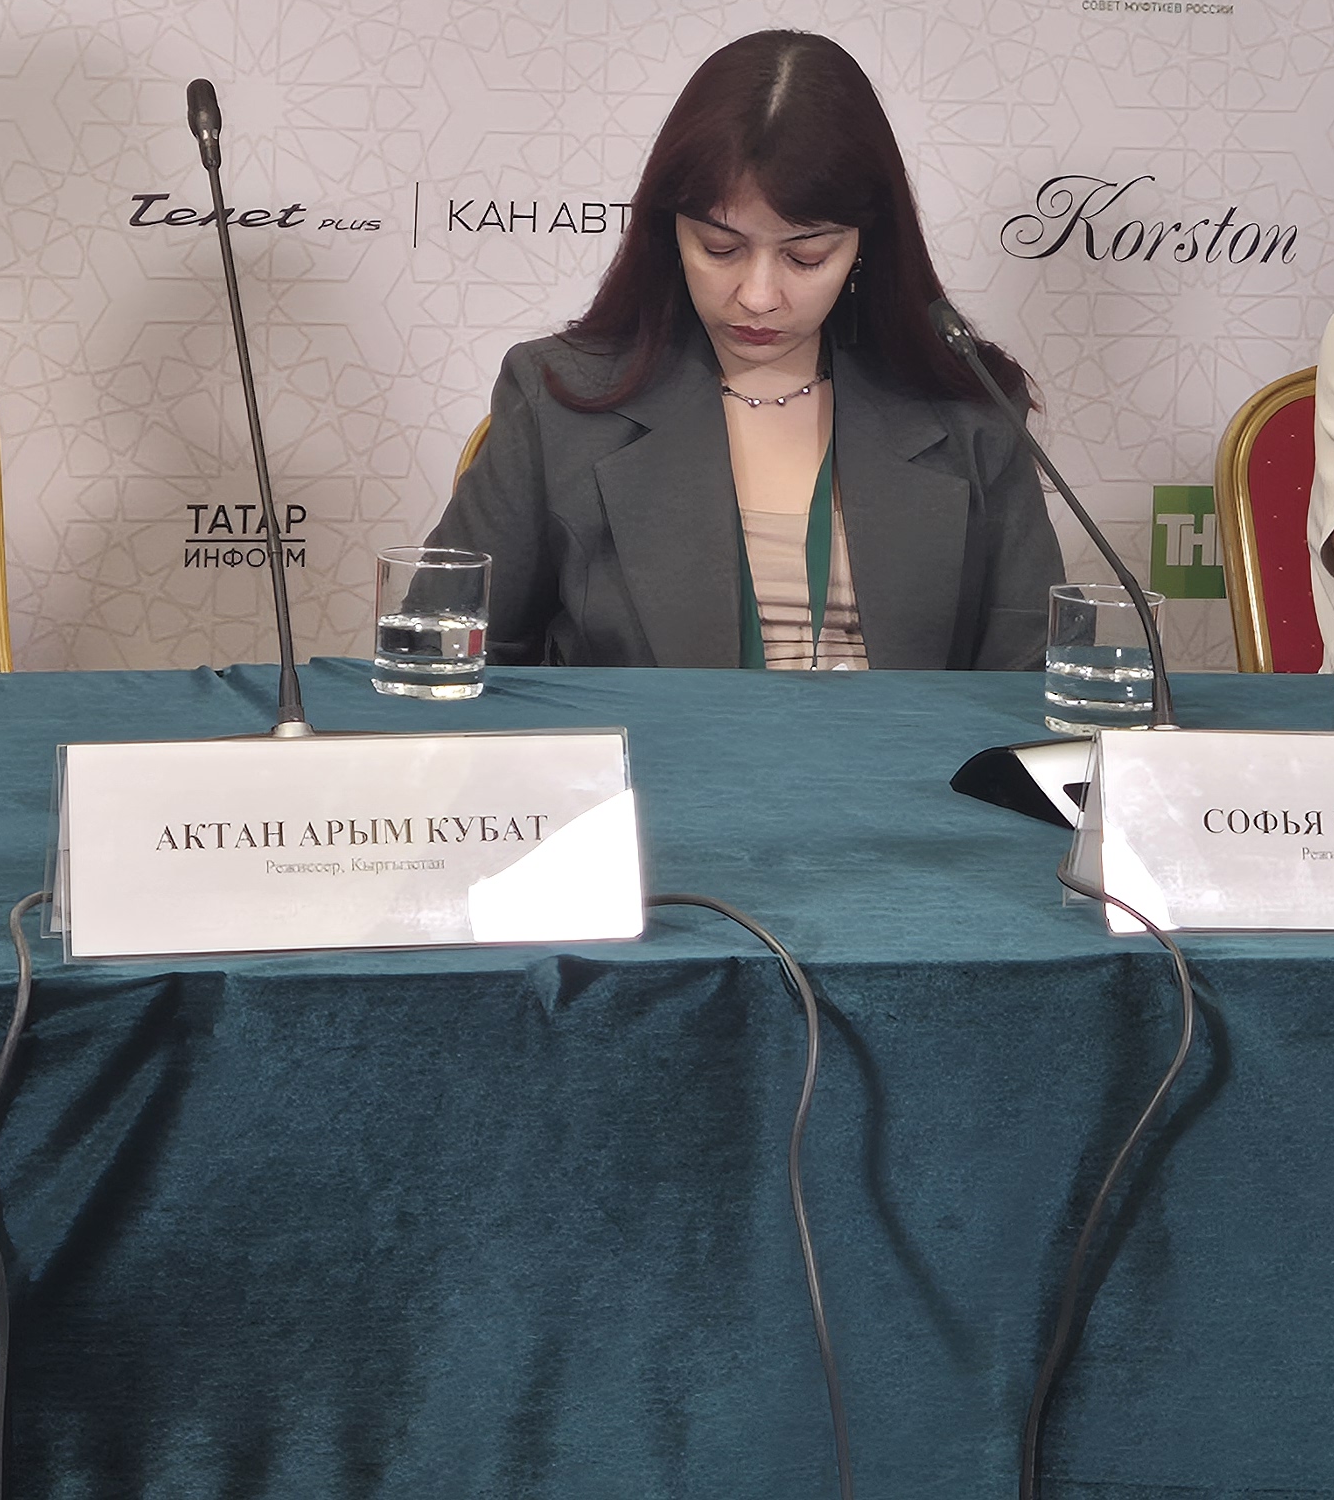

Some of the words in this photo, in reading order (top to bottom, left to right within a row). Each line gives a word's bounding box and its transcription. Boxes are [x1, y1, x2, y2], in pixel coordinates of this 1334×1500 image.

[1082, 0, 1120, 11] СОВЕТ
[317, 217, 381, 231] PLUS
[448, 198, 537, 233] КАН
[548, 201, 633, 235] АВТ
[1000, 174, 1304, 264] Korston
[184, 548, 305, 567] ИНФОМ
[155, 820, 286, 851] АКТАН
[299, 817, 414, 848] АРЫМ
[425, 814, 549, 843] КУБАТ
[1203, 808, 1325, 836] СОФЬЯ
